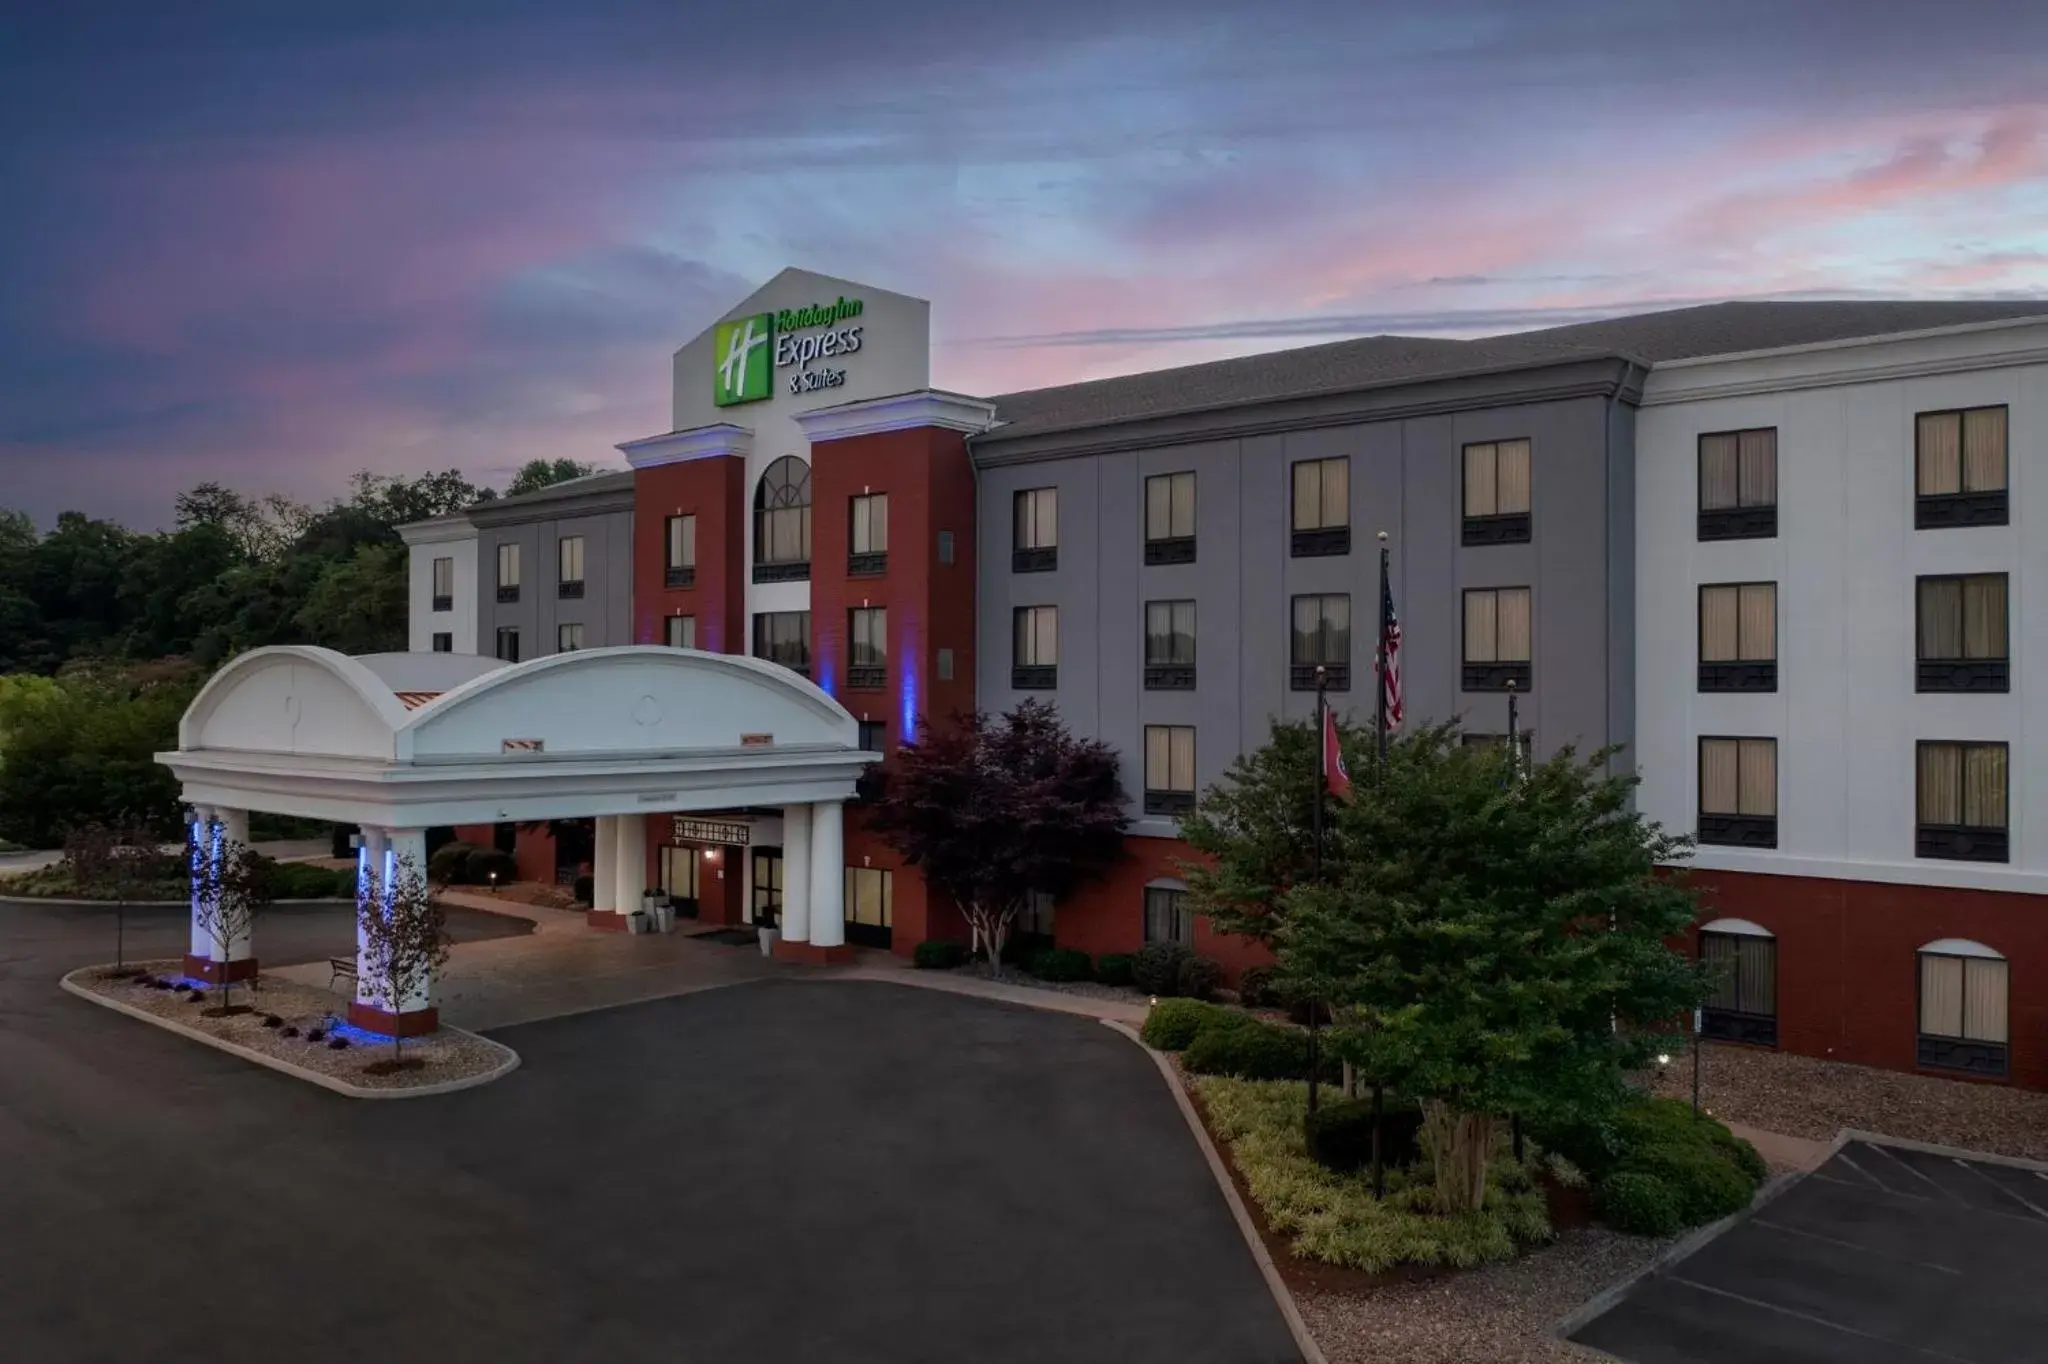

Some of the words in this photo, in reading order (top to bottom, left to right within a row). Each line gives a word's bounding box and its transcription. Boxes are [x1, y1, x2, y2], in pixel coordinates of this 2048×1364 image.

[776, 303, 835, 332] Holiday
[776, 327, 862, 369] Express
[788, 374, 801, 393] &
[801, 368, 845, 391] Suites
